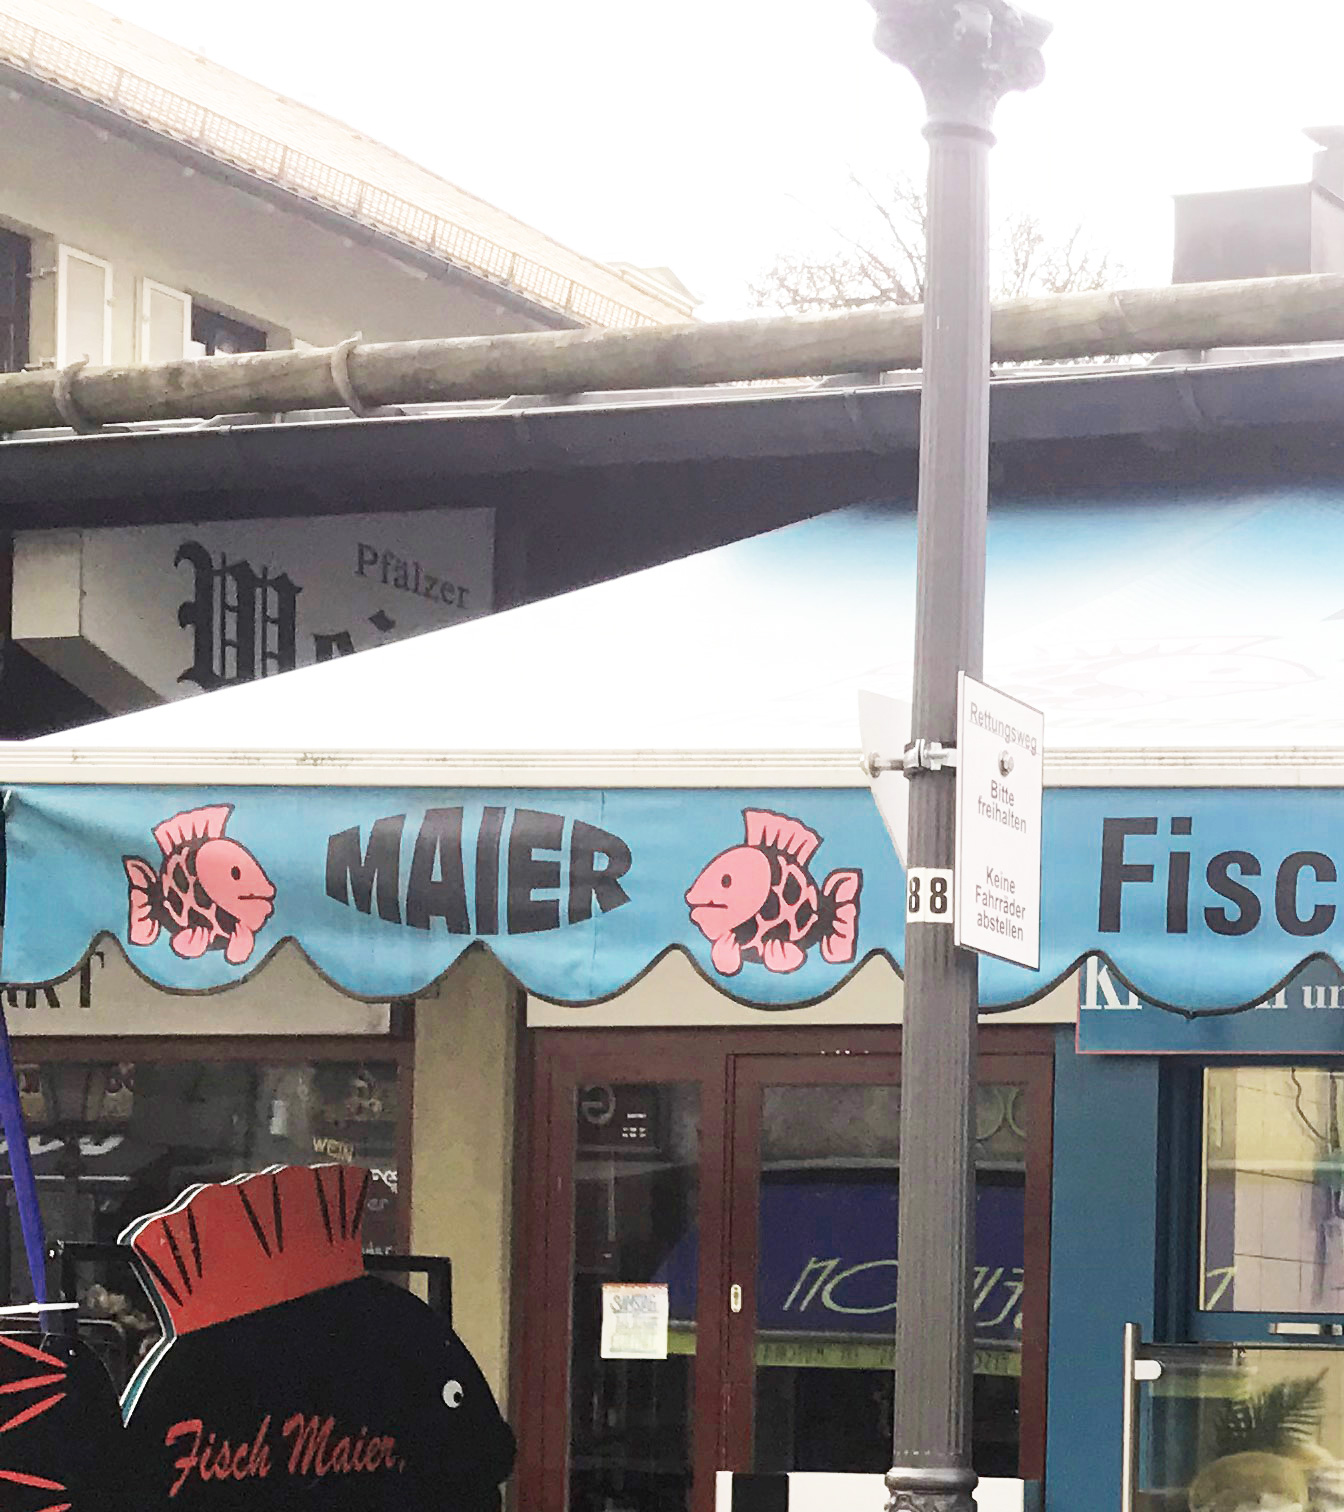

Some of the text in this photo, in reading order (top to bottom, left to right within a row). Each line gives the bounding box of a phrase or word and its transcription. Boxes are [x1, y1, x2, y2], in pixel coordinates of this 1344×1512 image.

[969, 701, 1038, 755] Rettungsweg
[990, 779, 1015, 807] Bitte
[977, 796, 1027, 833] freihalten
[325, 806, 633, 936] MAIER
[986, 866, 1016, 895] Keine
[975, 885, 1026, 920] Fahrräder
[976, 913, 1024, 942] abstellen
[164, 1414, 272, 1498] Fisch
